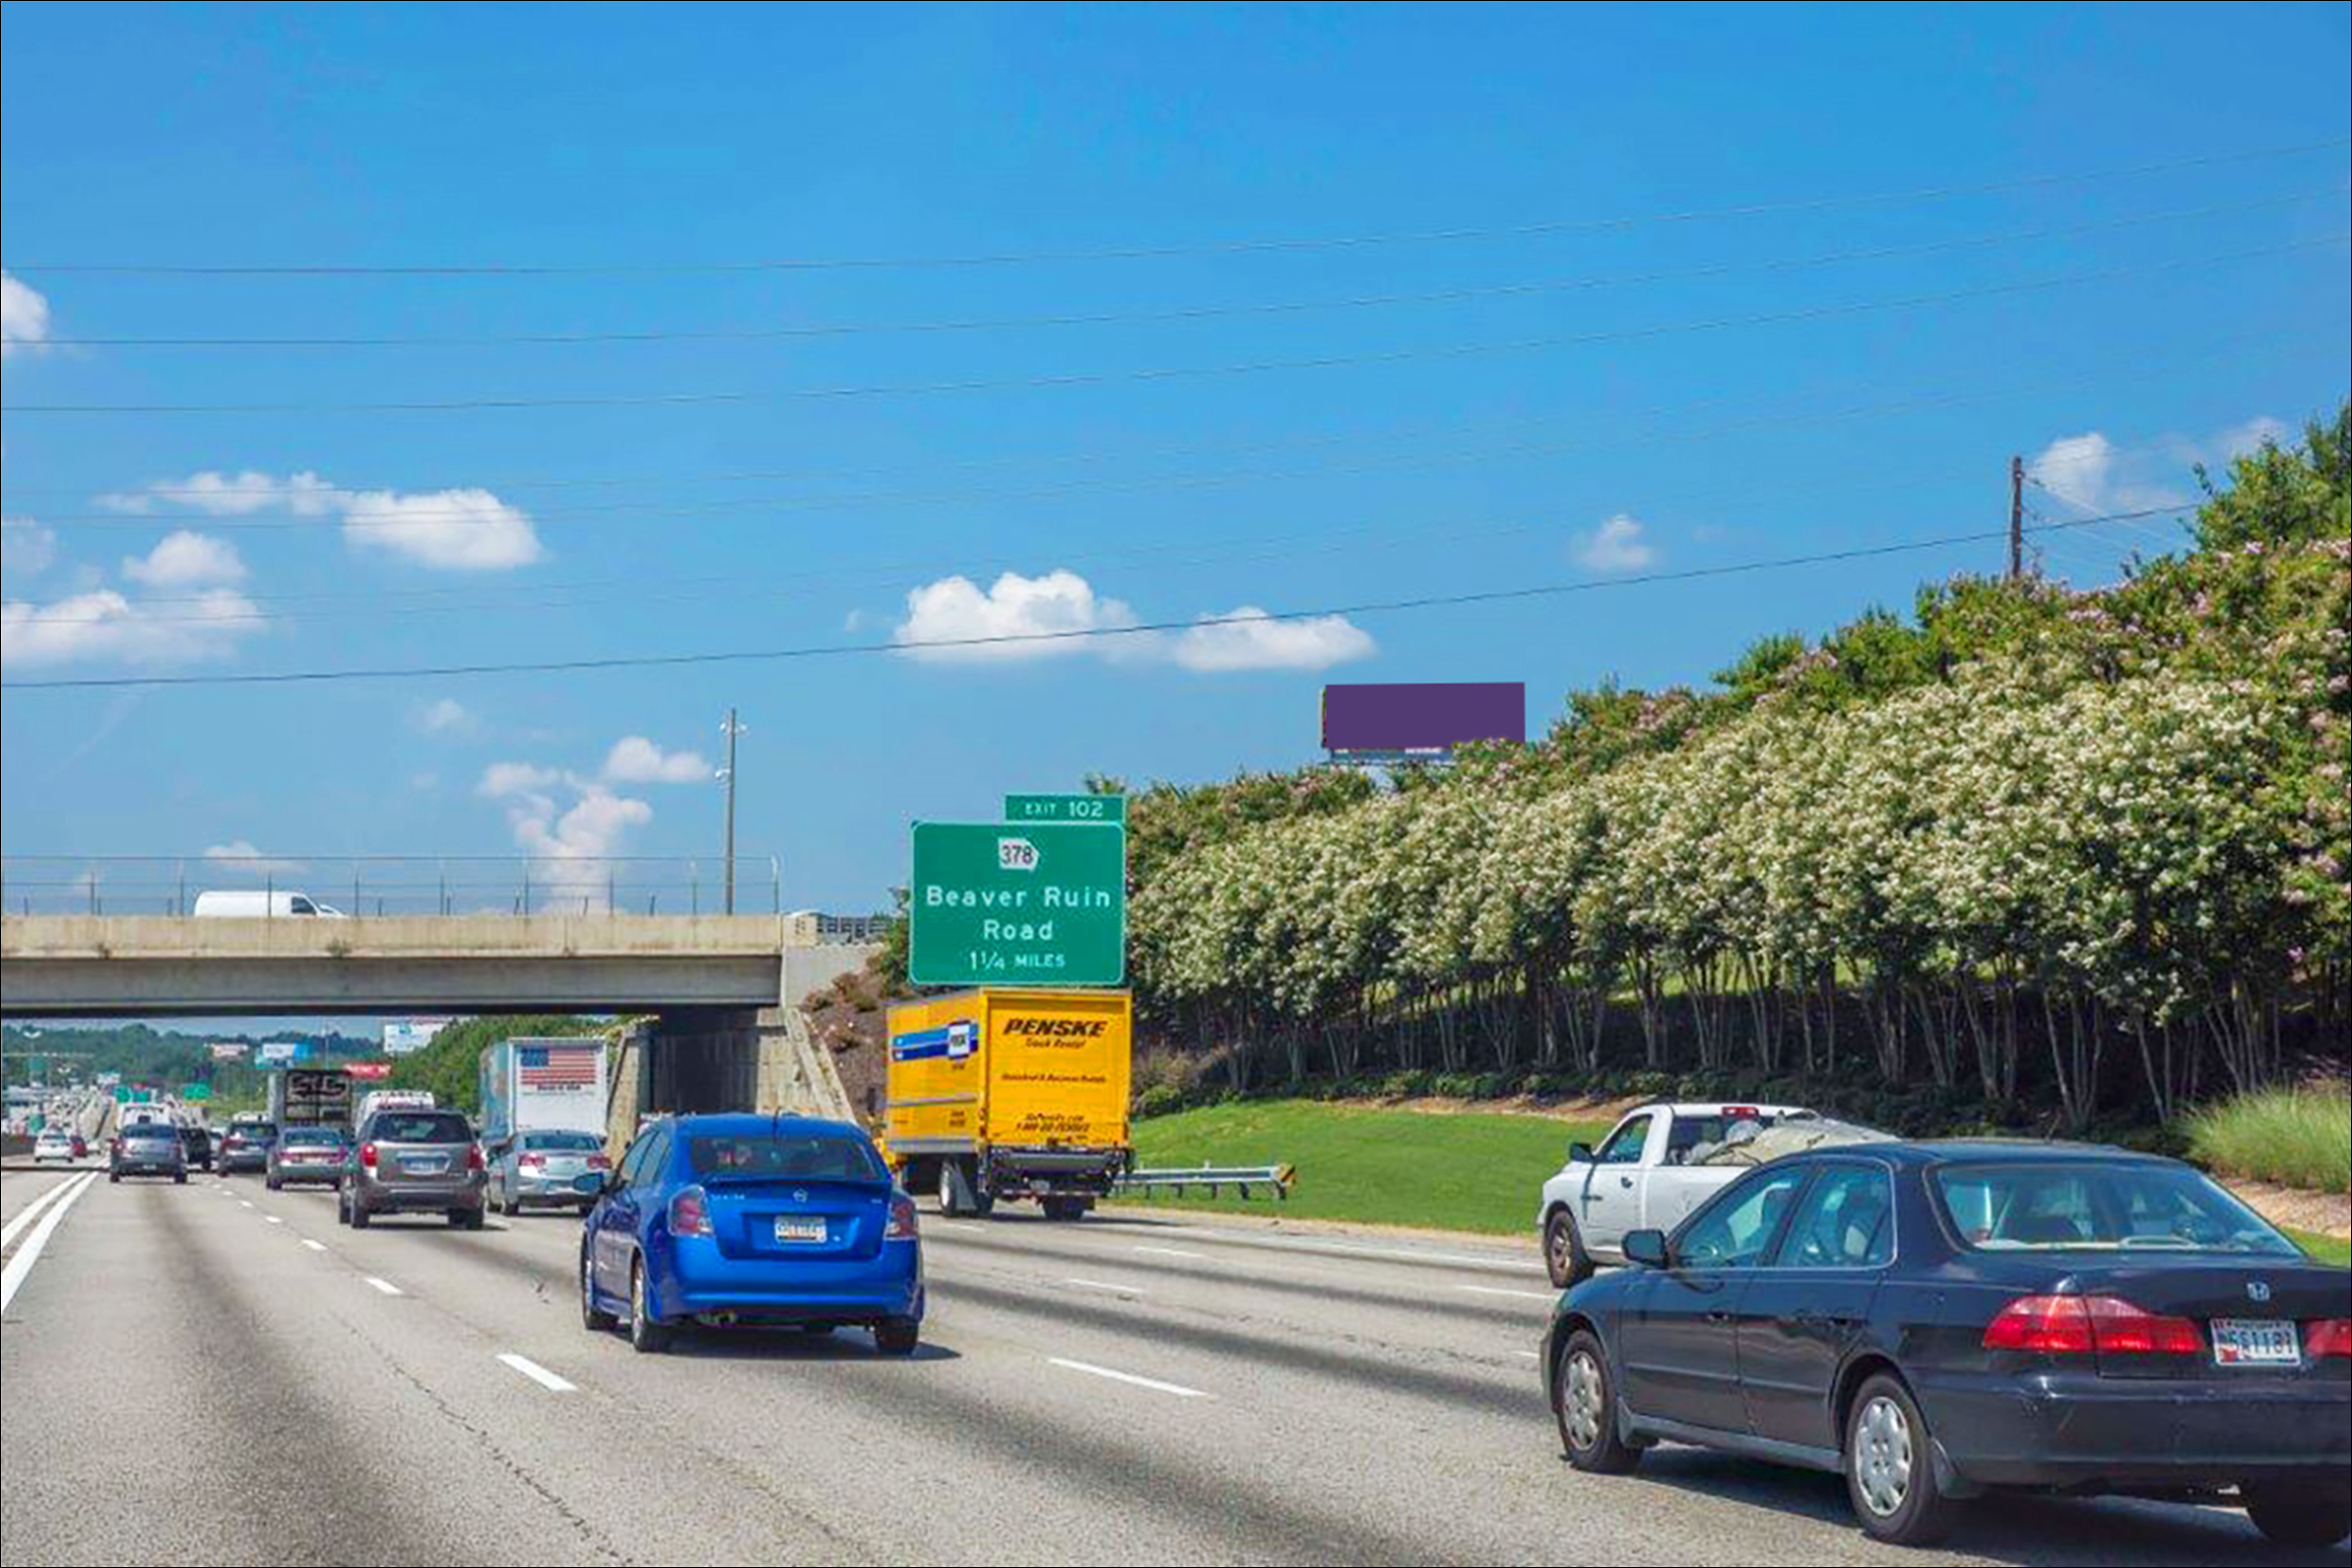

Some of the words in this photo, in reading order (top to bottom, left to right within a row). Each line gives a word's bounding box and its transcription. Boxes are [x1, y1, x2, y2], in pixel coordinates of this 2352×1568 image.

[1025, 802, 1055, 815] EXIT
[1069, 802, 1103, 817] 102
[1002, 844, 1035, 865] 378
[926, 885, 1027, 907] Beaver
[1044, 886, 1111, 907] Ruin
[983, 919, 1054, 941] Road
[1014, 954, 1066, 968] MILES
[1003, 1018, 1108, 1038] PENSKE
